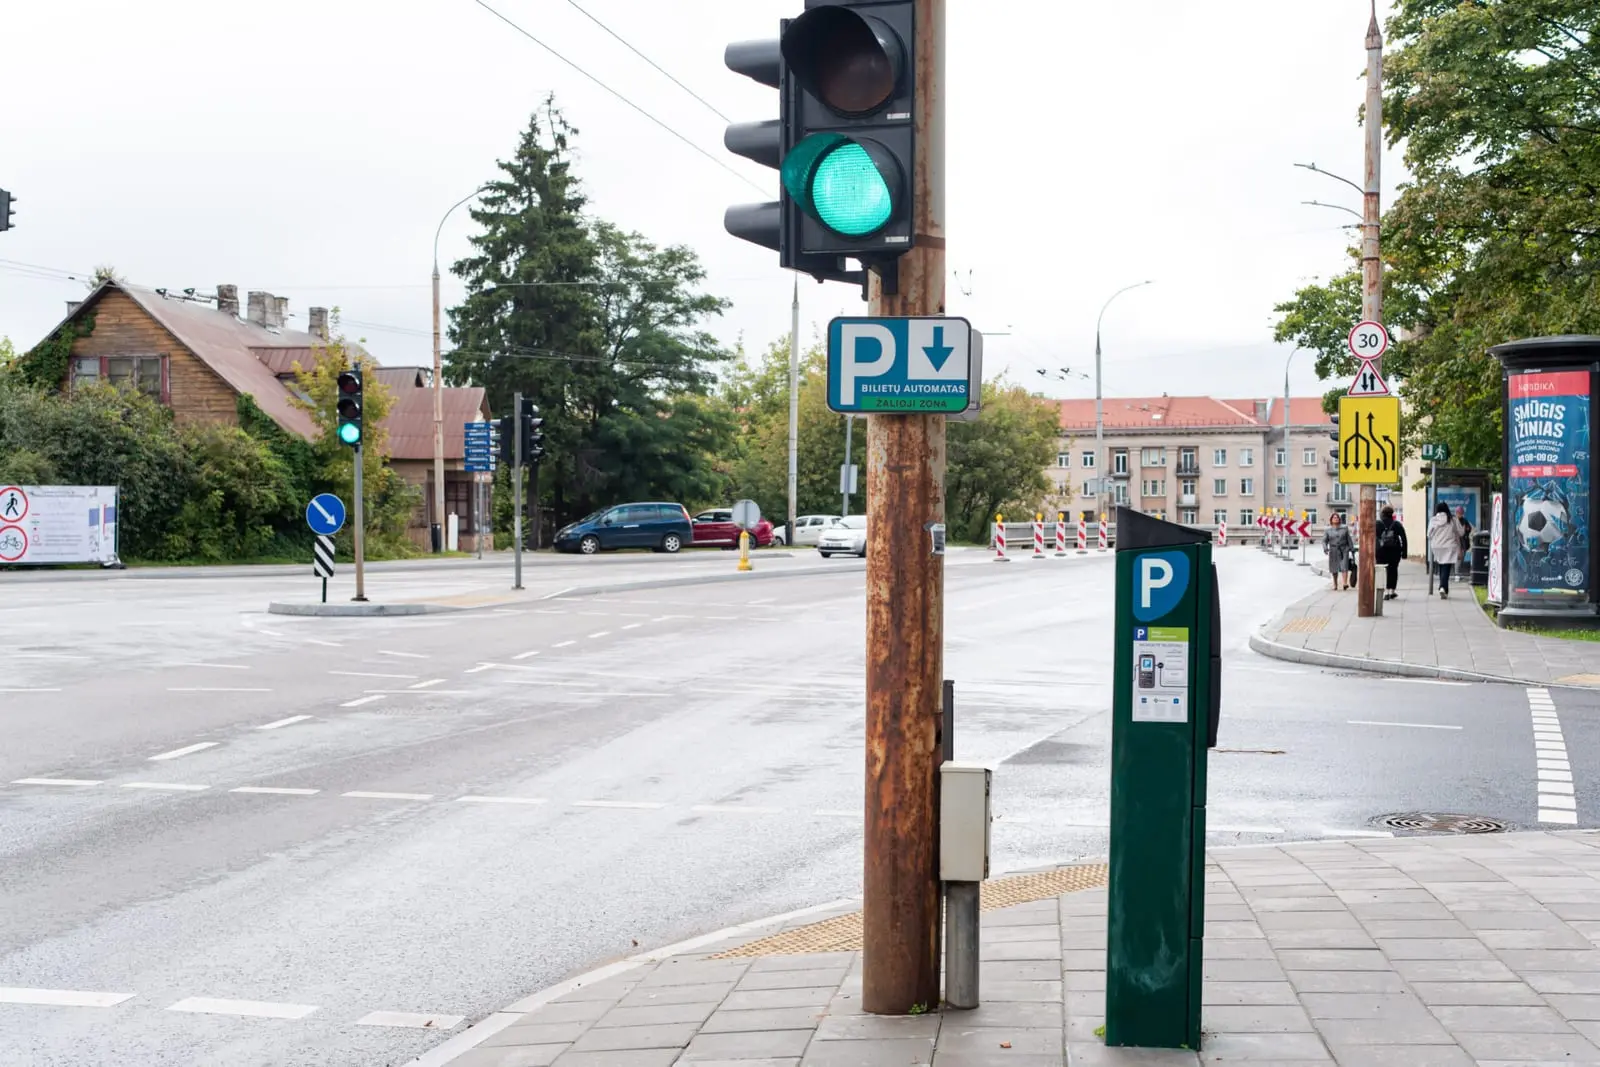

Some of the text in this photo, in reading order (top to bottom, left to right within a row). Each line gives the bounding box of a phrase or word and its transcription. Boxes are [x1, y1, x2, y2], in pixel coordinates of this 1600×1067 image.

[1359, 334, 1378, 348] 30
[840, 324, 896, 405] P
[861, 384, 965, 395] BILIETŲ AUTOMATAS
[876, 398, 947, 408] ŽALIOJI ZONA
[1514, 400, 1566, 422] SMŪGIS
[1141, 558, 1174, 608] P
[1137, 629, 1145, 639] P
